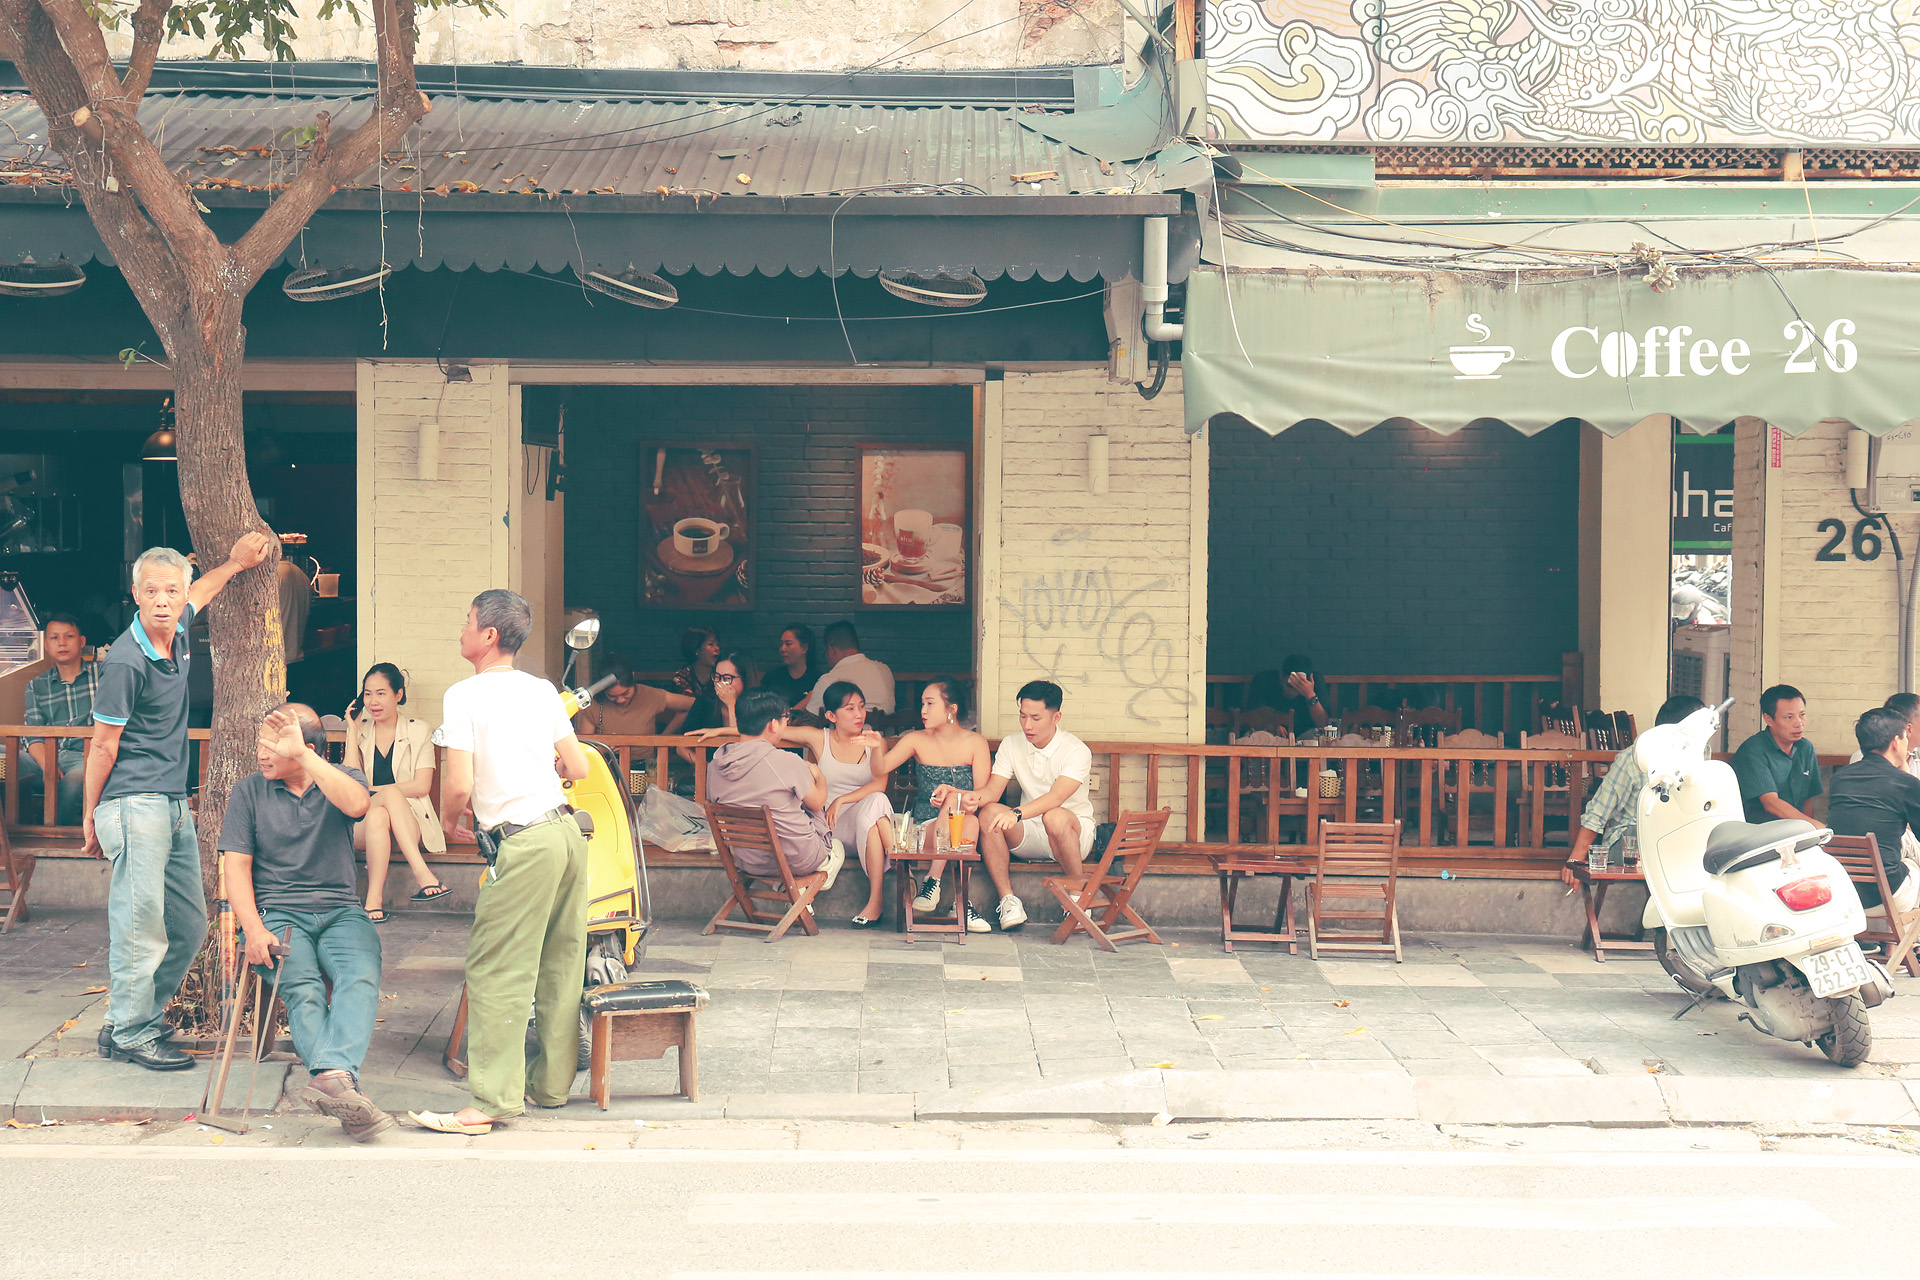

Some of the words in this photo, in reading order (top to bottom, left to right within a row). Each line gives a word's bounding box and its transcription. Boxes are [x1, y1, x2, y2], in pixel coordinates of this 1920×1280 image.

[1551, 325, 1750, 379] Coffee
[1783, 318, 1858, 374] 26
[1815, 517, 1882, 562] 26
[1810, 947, 1854, 974] 29-C1
[1814, 964, 1867, 993] 252.53
